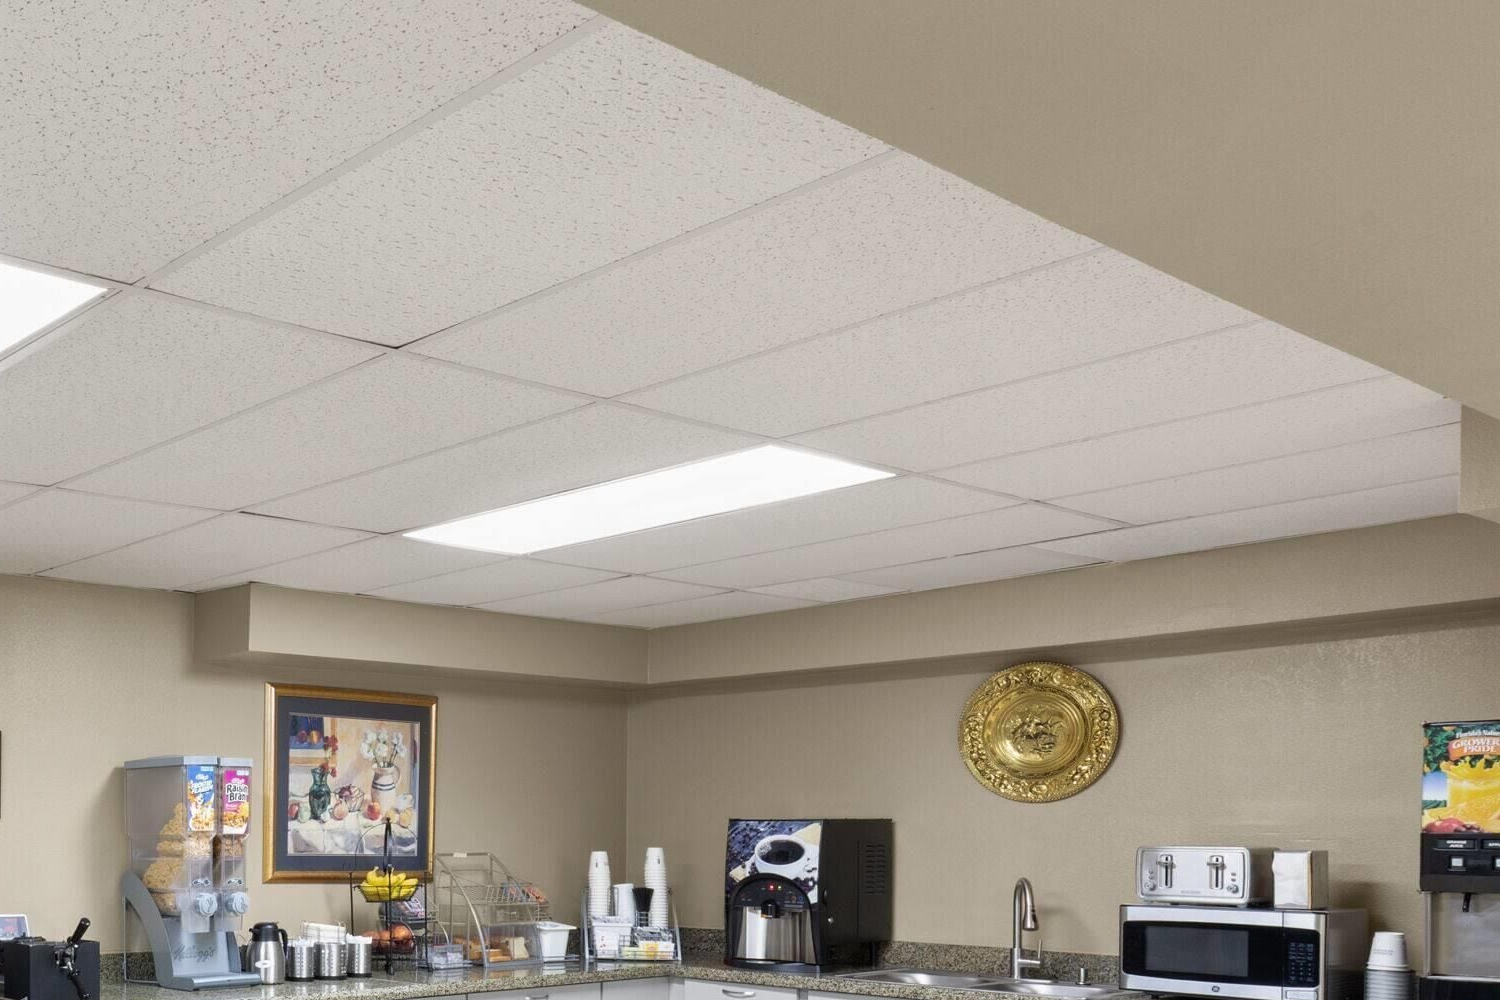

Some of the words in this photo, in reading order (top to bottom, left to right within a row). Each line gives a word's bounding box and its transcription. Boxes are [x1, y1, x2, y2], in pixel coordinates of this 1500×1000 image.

[1464, 745, 1497, 753] PRIDE
[226, 784, 248, 793] Raisin
[228, 793, 246, 802] Bran
